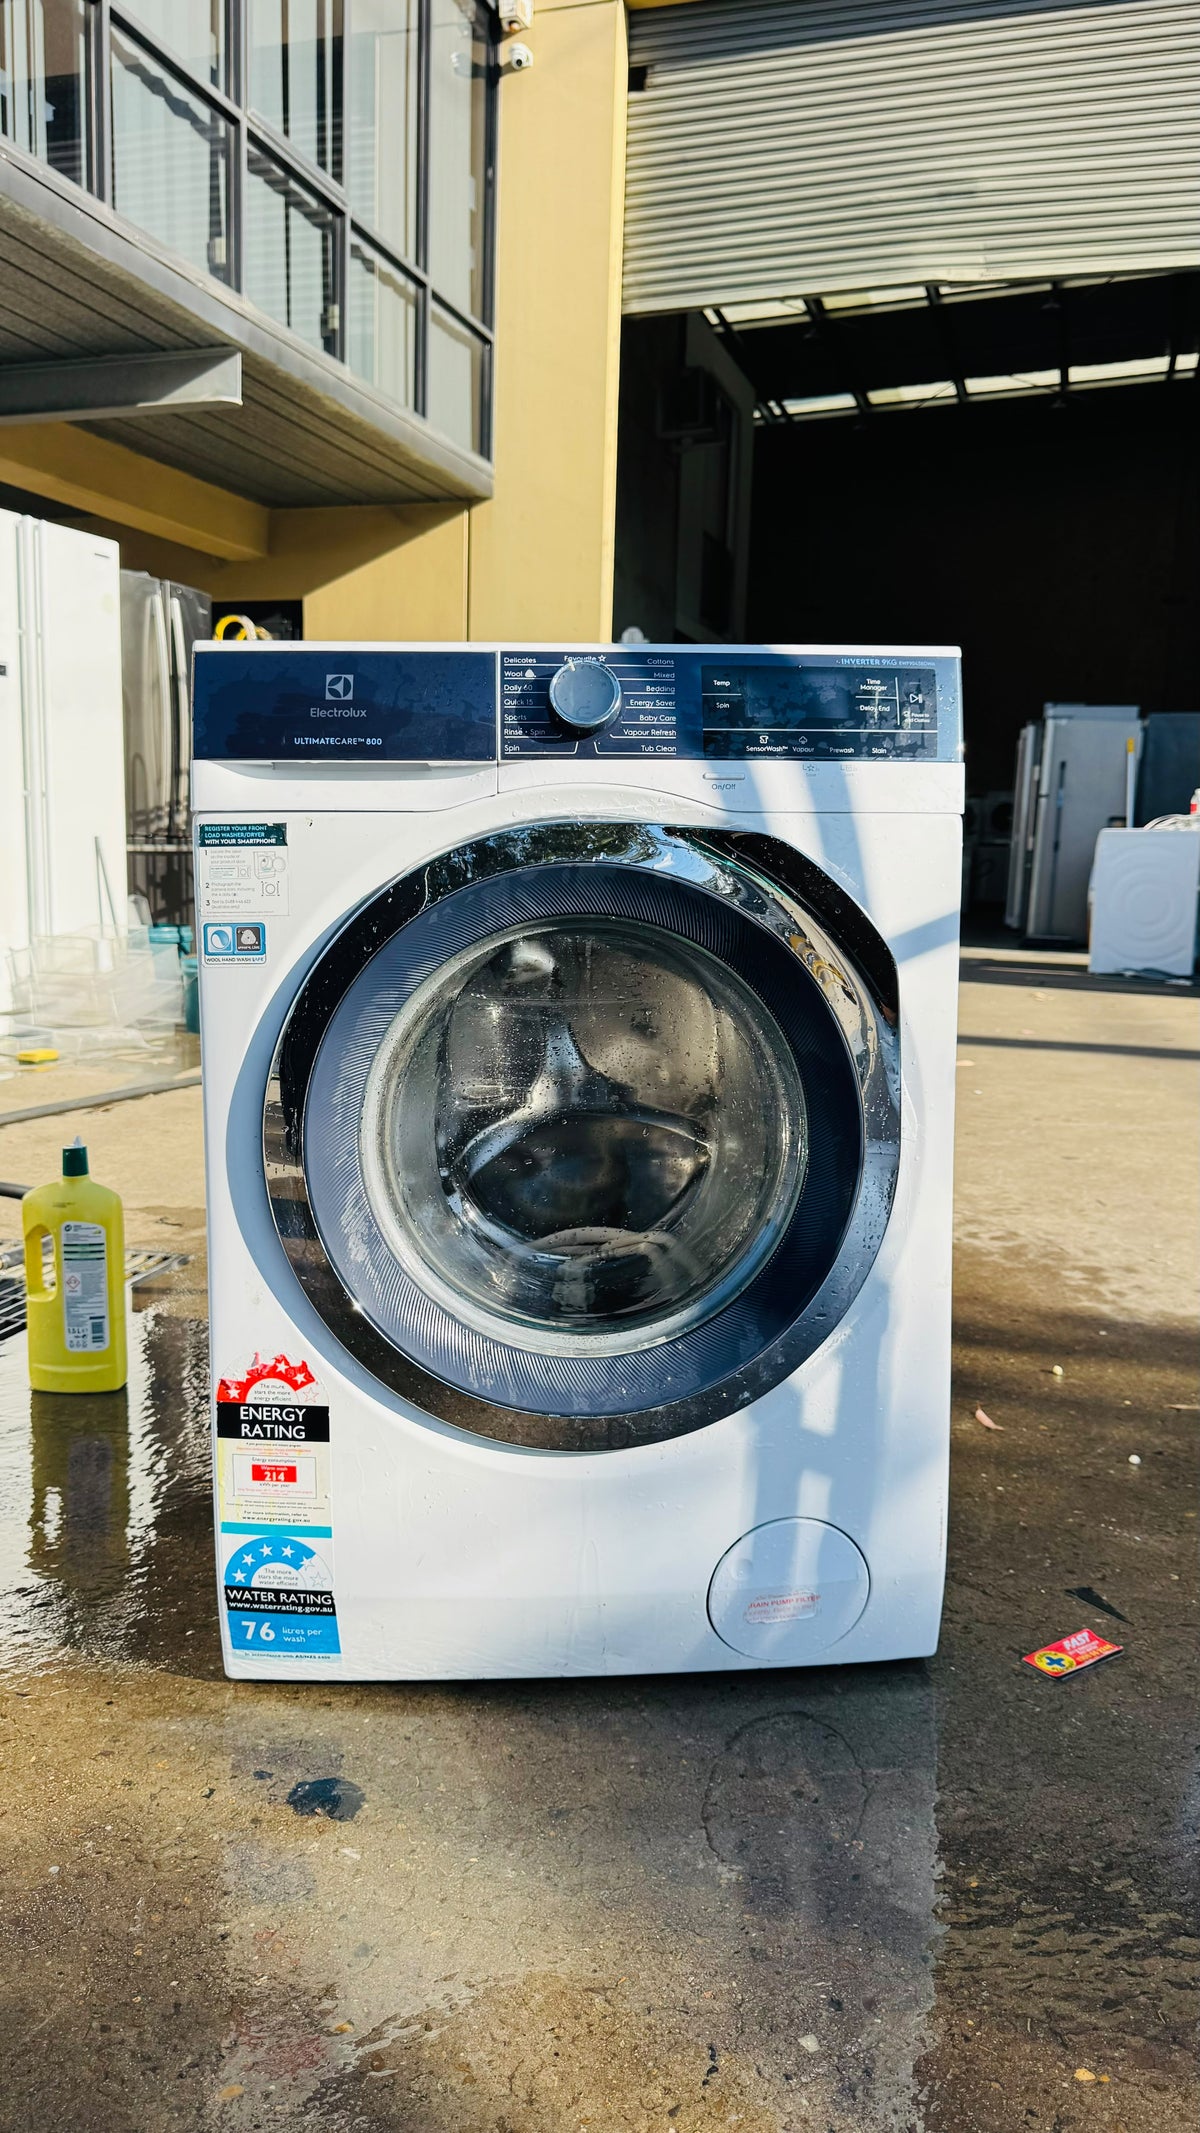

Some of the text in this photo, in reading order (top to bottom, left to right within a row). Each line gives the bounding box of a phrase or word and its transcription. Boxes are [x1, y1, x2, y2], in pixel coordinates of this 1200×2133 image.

[841, 658, 880, 666] INVERTER
[504, 684, 523, 692] Daily
[646, 685, 676, 694] Bedding
[630, 699, 654, 708] Energy
[860, 704, 878, 712] Delay
[310, 708, 367, 718] Electrolux
[640, 714, 658, 722] Baby
[623, 729, 650, 737] Vapour
[366, 737, 382, 746] 800
[504, 744, 520, 752] Spin
[240, 1406, 306, 1422] ENERGY
[241, 1423, 306, 1440] RATING
[264, 1472, 285, 1482] 214
[227, 1588, 332, 1605] WATER RATING
[228, 1600, 333, 1613] www.waterrating.gov.au
[241, 1620, 276, 1641] 76
[282, 1626, 322, 1636] litres per
[1063, 1632, 1090, 1650] FAST
